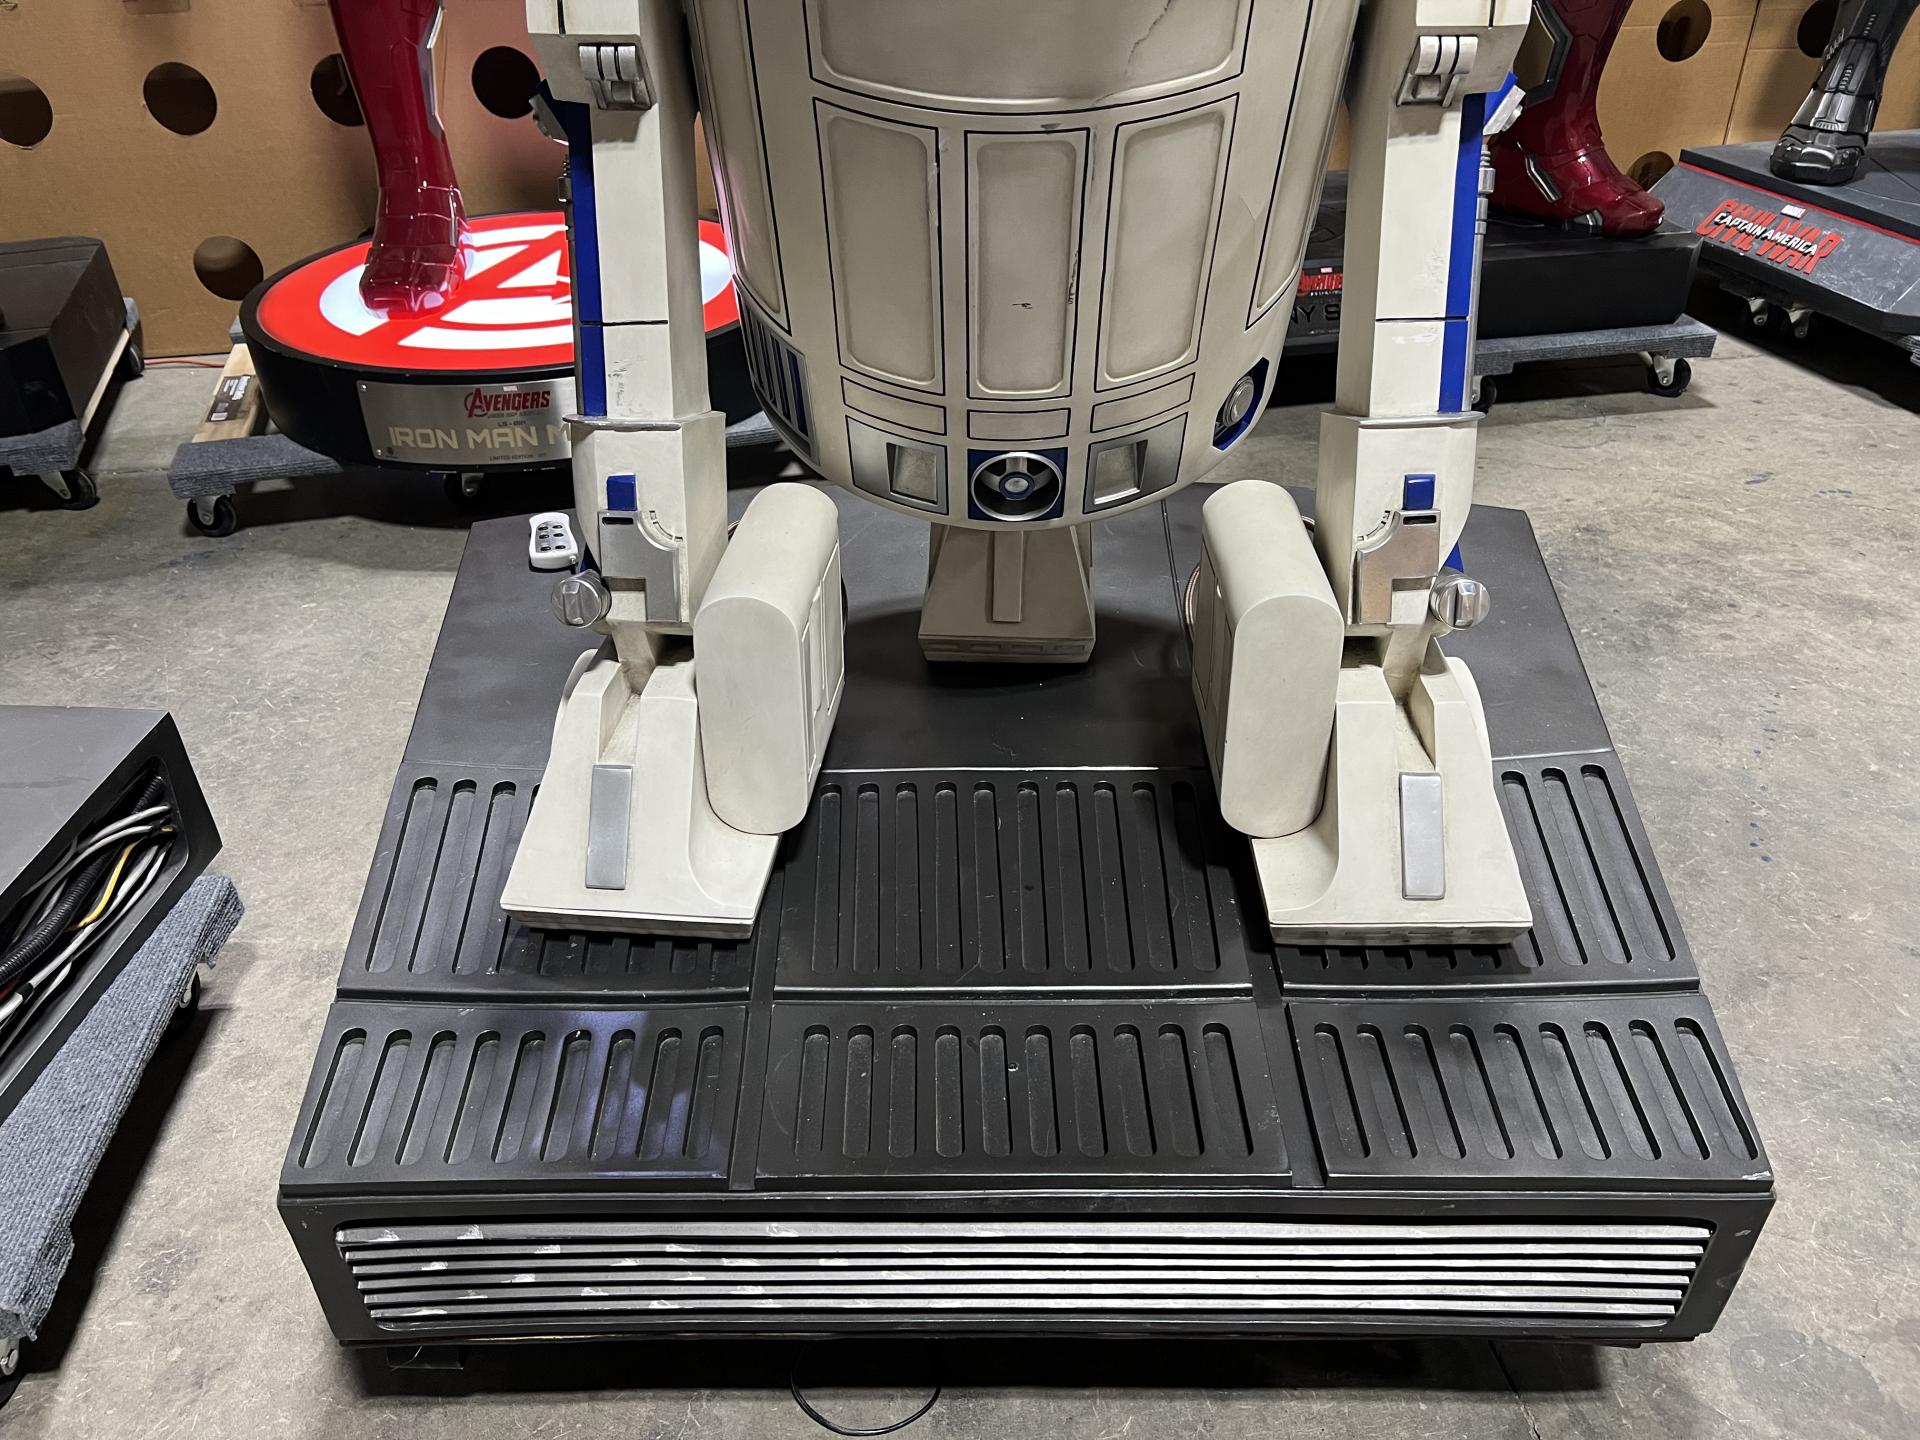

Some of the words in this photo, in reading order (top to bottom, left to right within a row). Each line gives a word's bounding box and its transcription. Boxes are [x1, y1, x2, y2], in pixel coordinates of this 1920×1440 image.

[1713, 212, 1767, 240] CAPTAIN
[1762, 227, 1818, 256] AMERICA
[464, 387, 551, 418] AVENGERS
[388, 425, 459, 449] IRON
[465, 426, 539, 449] MAN
